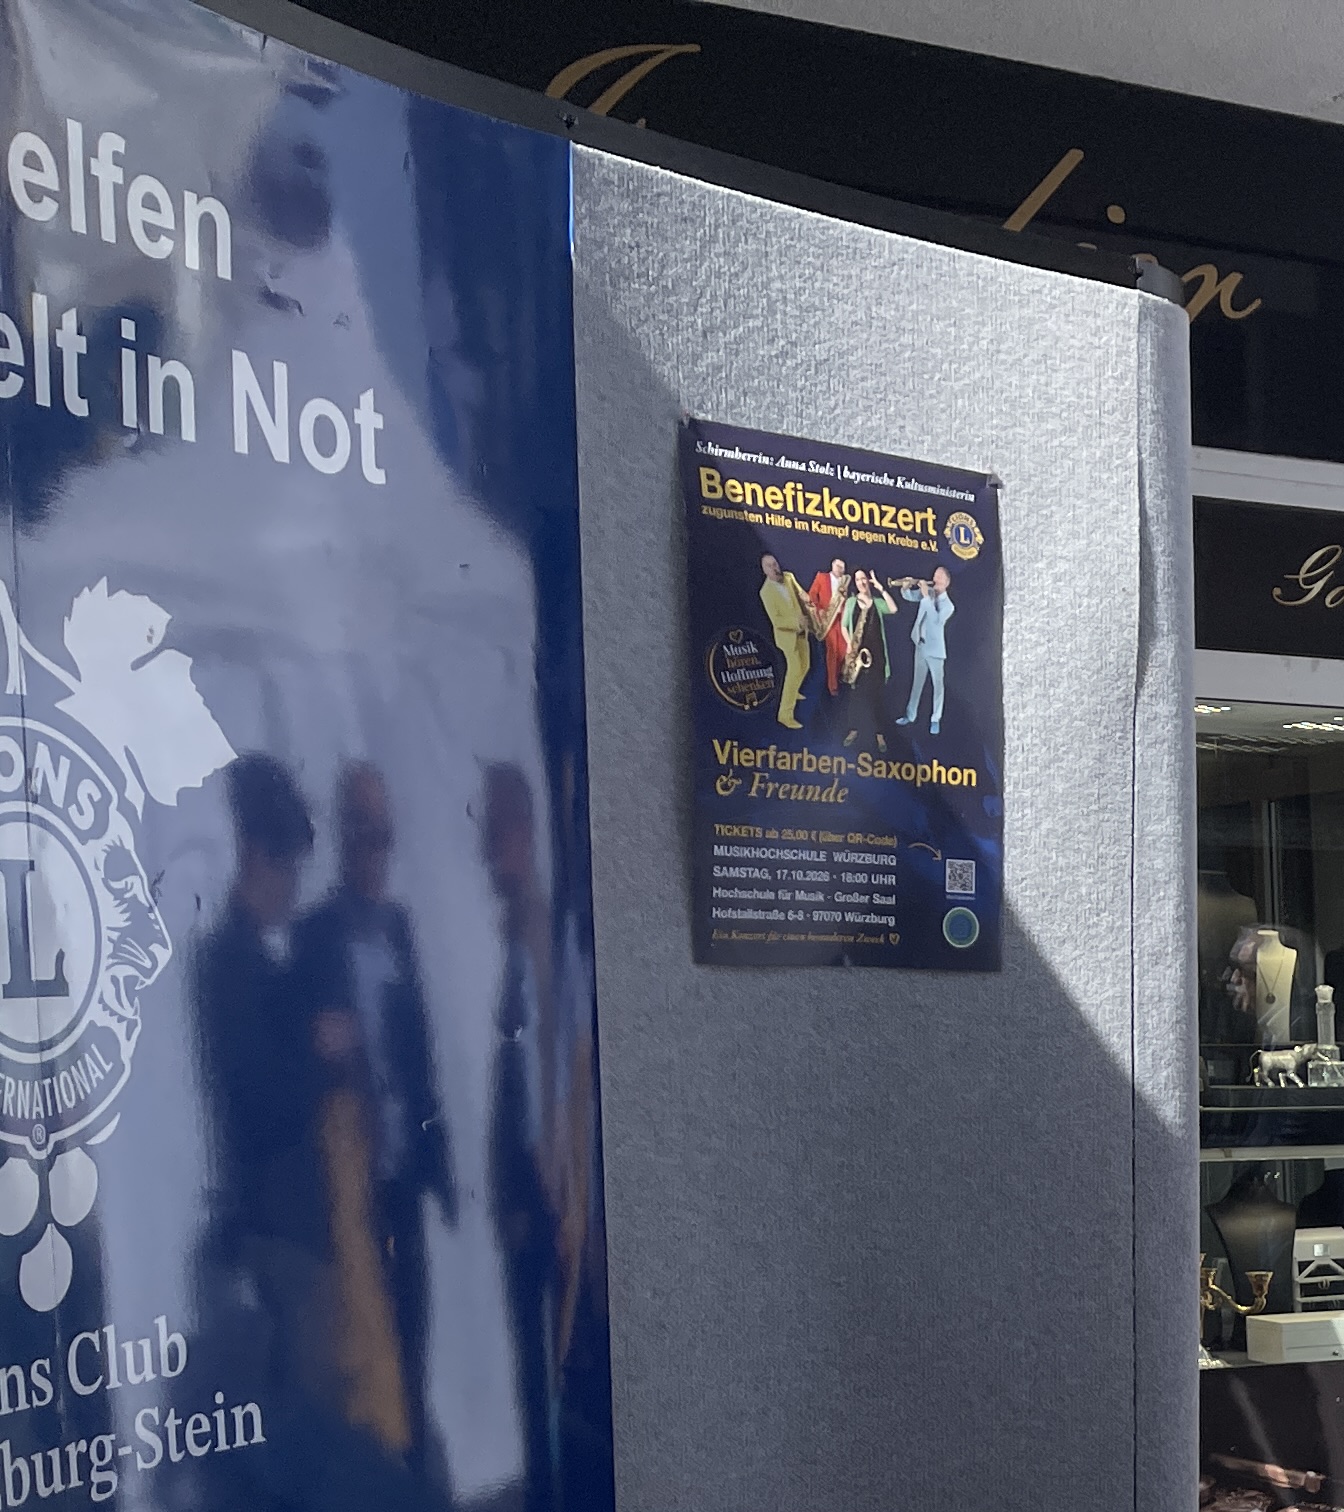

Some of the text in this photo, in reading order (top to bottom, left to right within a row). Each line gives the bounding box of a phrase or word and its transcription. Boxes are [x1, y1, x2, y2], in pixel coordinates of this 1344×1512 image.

[7, 117, 233, 280] elfen
[120, 317, 197, 443] in
[231, 349, 386, 485] Not
[699, 467, 937, 536] Benefizkonzert
[775, 455, 806, 472] Anna
[808, 460, 834, 476] Stolz
[842, 463, 895, 488] bayerische
[896, 476, 975, 503] Kultusministerin
[701, 505, 763, 524] zugunsten
[765, 512, 792, 529] Hilfe
[794, 516, 809, 531] im
[811, 519, 849, 538] Kampf
[852, 528, 886, 545] gegen
[888, 533, 918, 549] Krebs
[722, 641, 758, 656] Musik
[721, 666, 774, 683] Hoffnung
[0, 735, 103, 831] ONS
[712, 738, 977, 787] Vierfarben-Saxophon
[748, 772, 849, 803] Freunde
[714, 824, 762, 838] TICKETS
[713, 845, 897, 866] MUSIKHOCHSCHULE WÜRZBURG
[713, 866, 772, 881] SAMSTAG,
[871, 873, 896, 886] UHR
[712, 886, 896, 905] Hochschule für Musik Großer Saal
[844, 911, 895, 927] Würzburg
[0, 1042, 113, 1120] RNATIONAL
[0, 1314, 187, 1416] ns Club
[0, 1391, 267, 1507] burg-Stein
